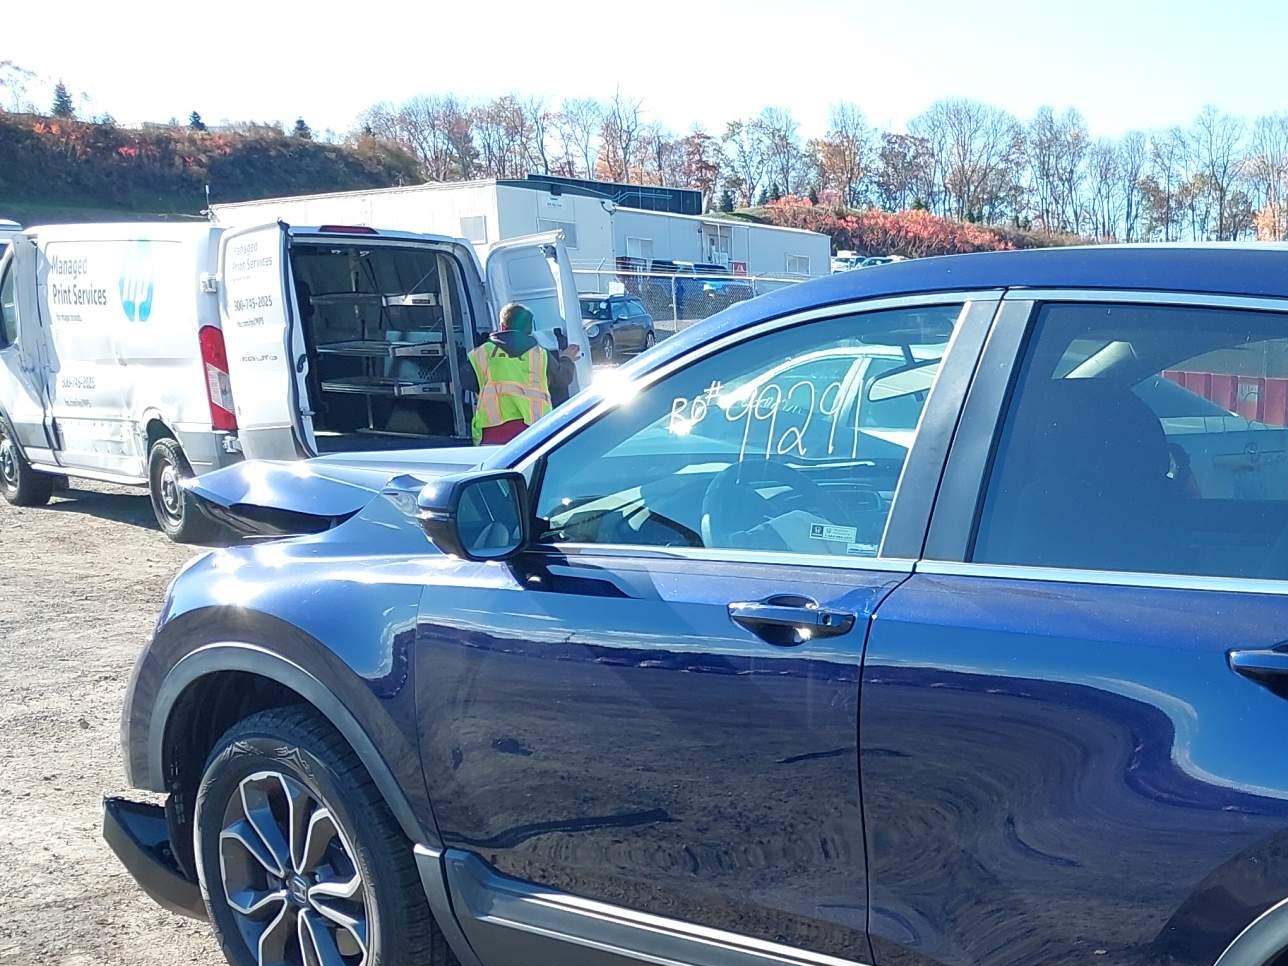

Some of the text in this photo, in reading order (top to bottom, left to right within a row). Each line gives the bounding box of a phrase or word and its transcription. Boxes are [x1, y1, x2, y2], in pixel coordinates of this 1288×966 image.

[51, 255, 87, 280] Managed
[52, 283, 107, 305] Print Services
